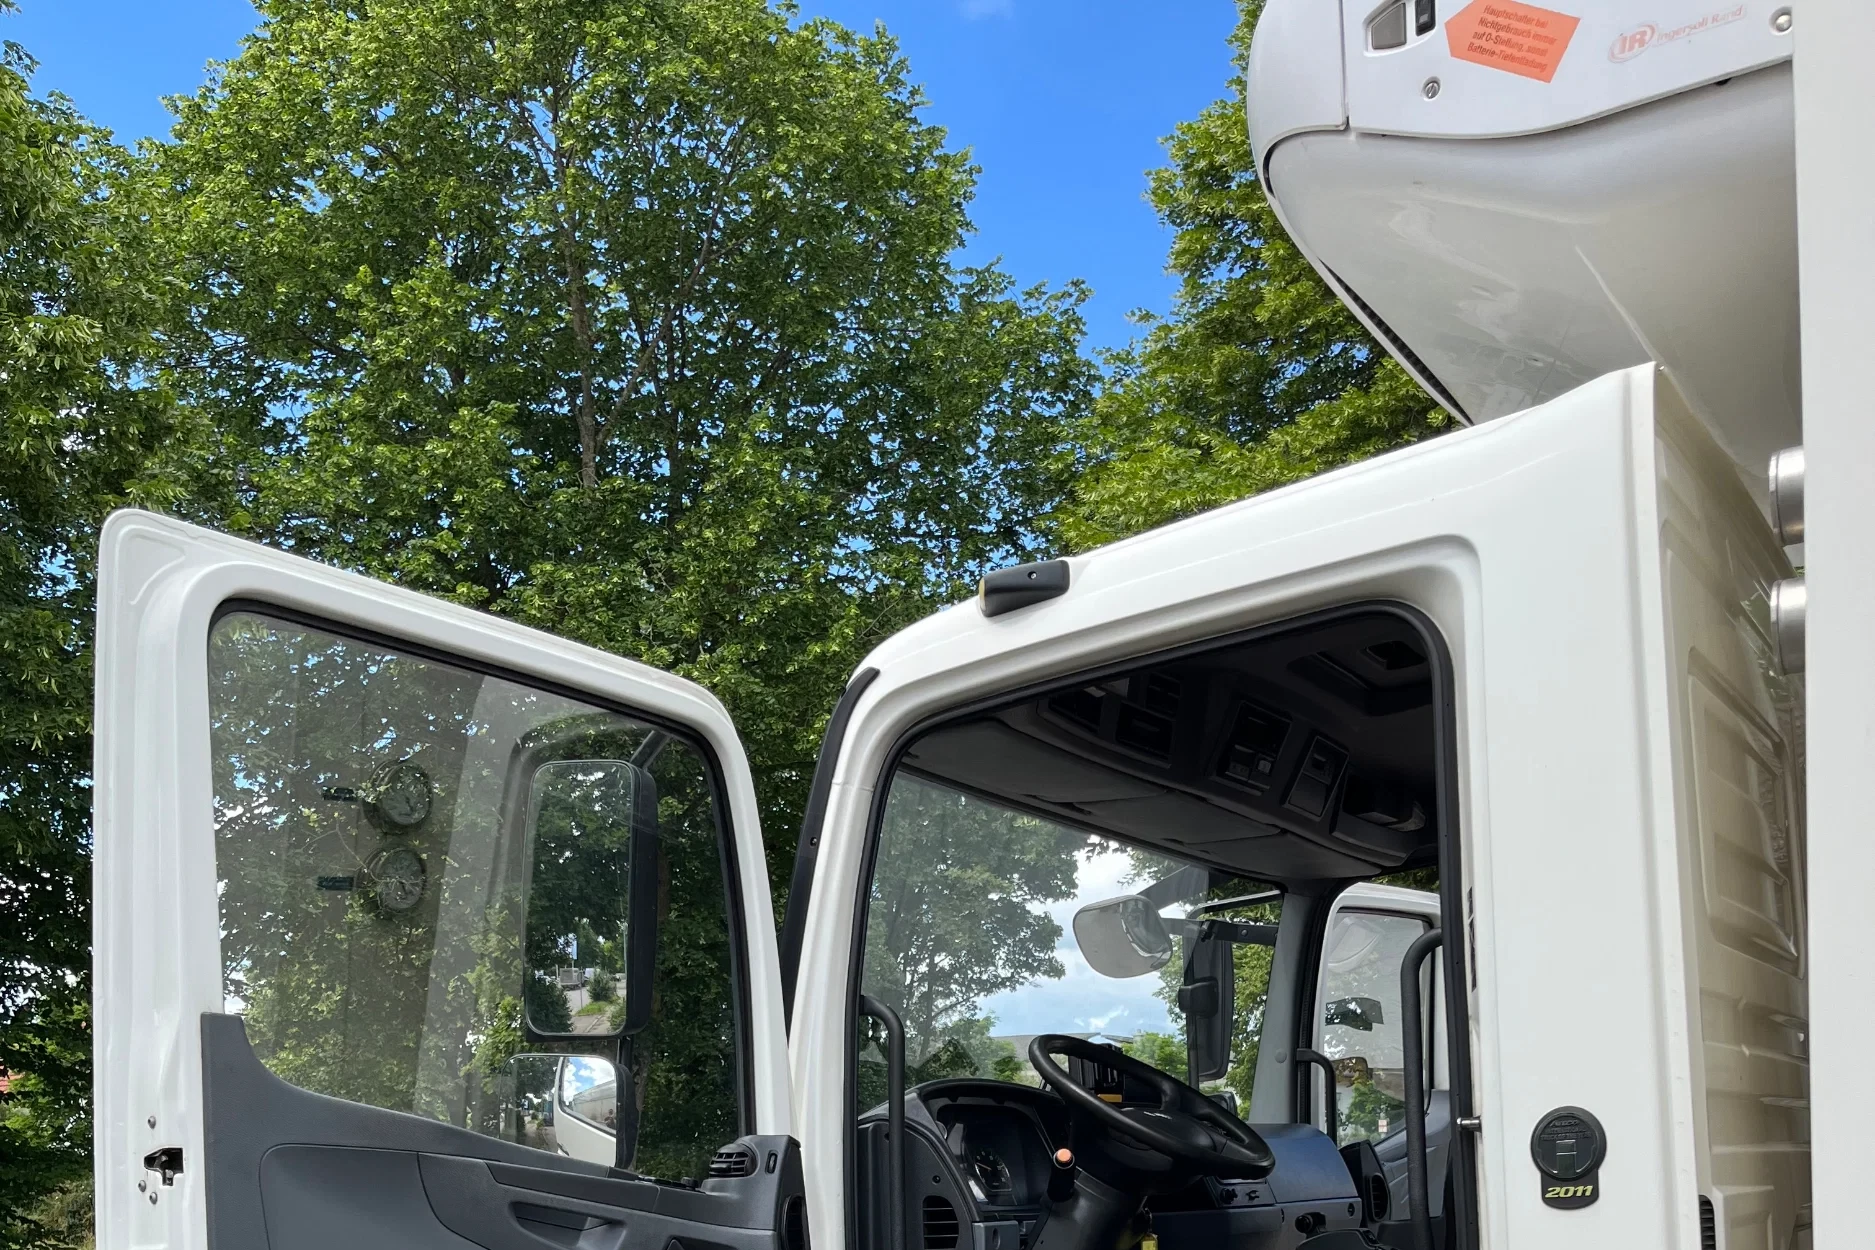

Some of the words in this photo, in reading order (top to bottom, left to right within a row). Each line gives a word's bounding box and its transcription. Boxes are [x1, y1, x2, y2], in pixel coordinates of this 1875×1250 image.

[1478, 17, 1531, 38] Nichtgebrauch
[1472, 31, 1485, 40] auf
[1545, 1185, 1593, 1198] 2011
